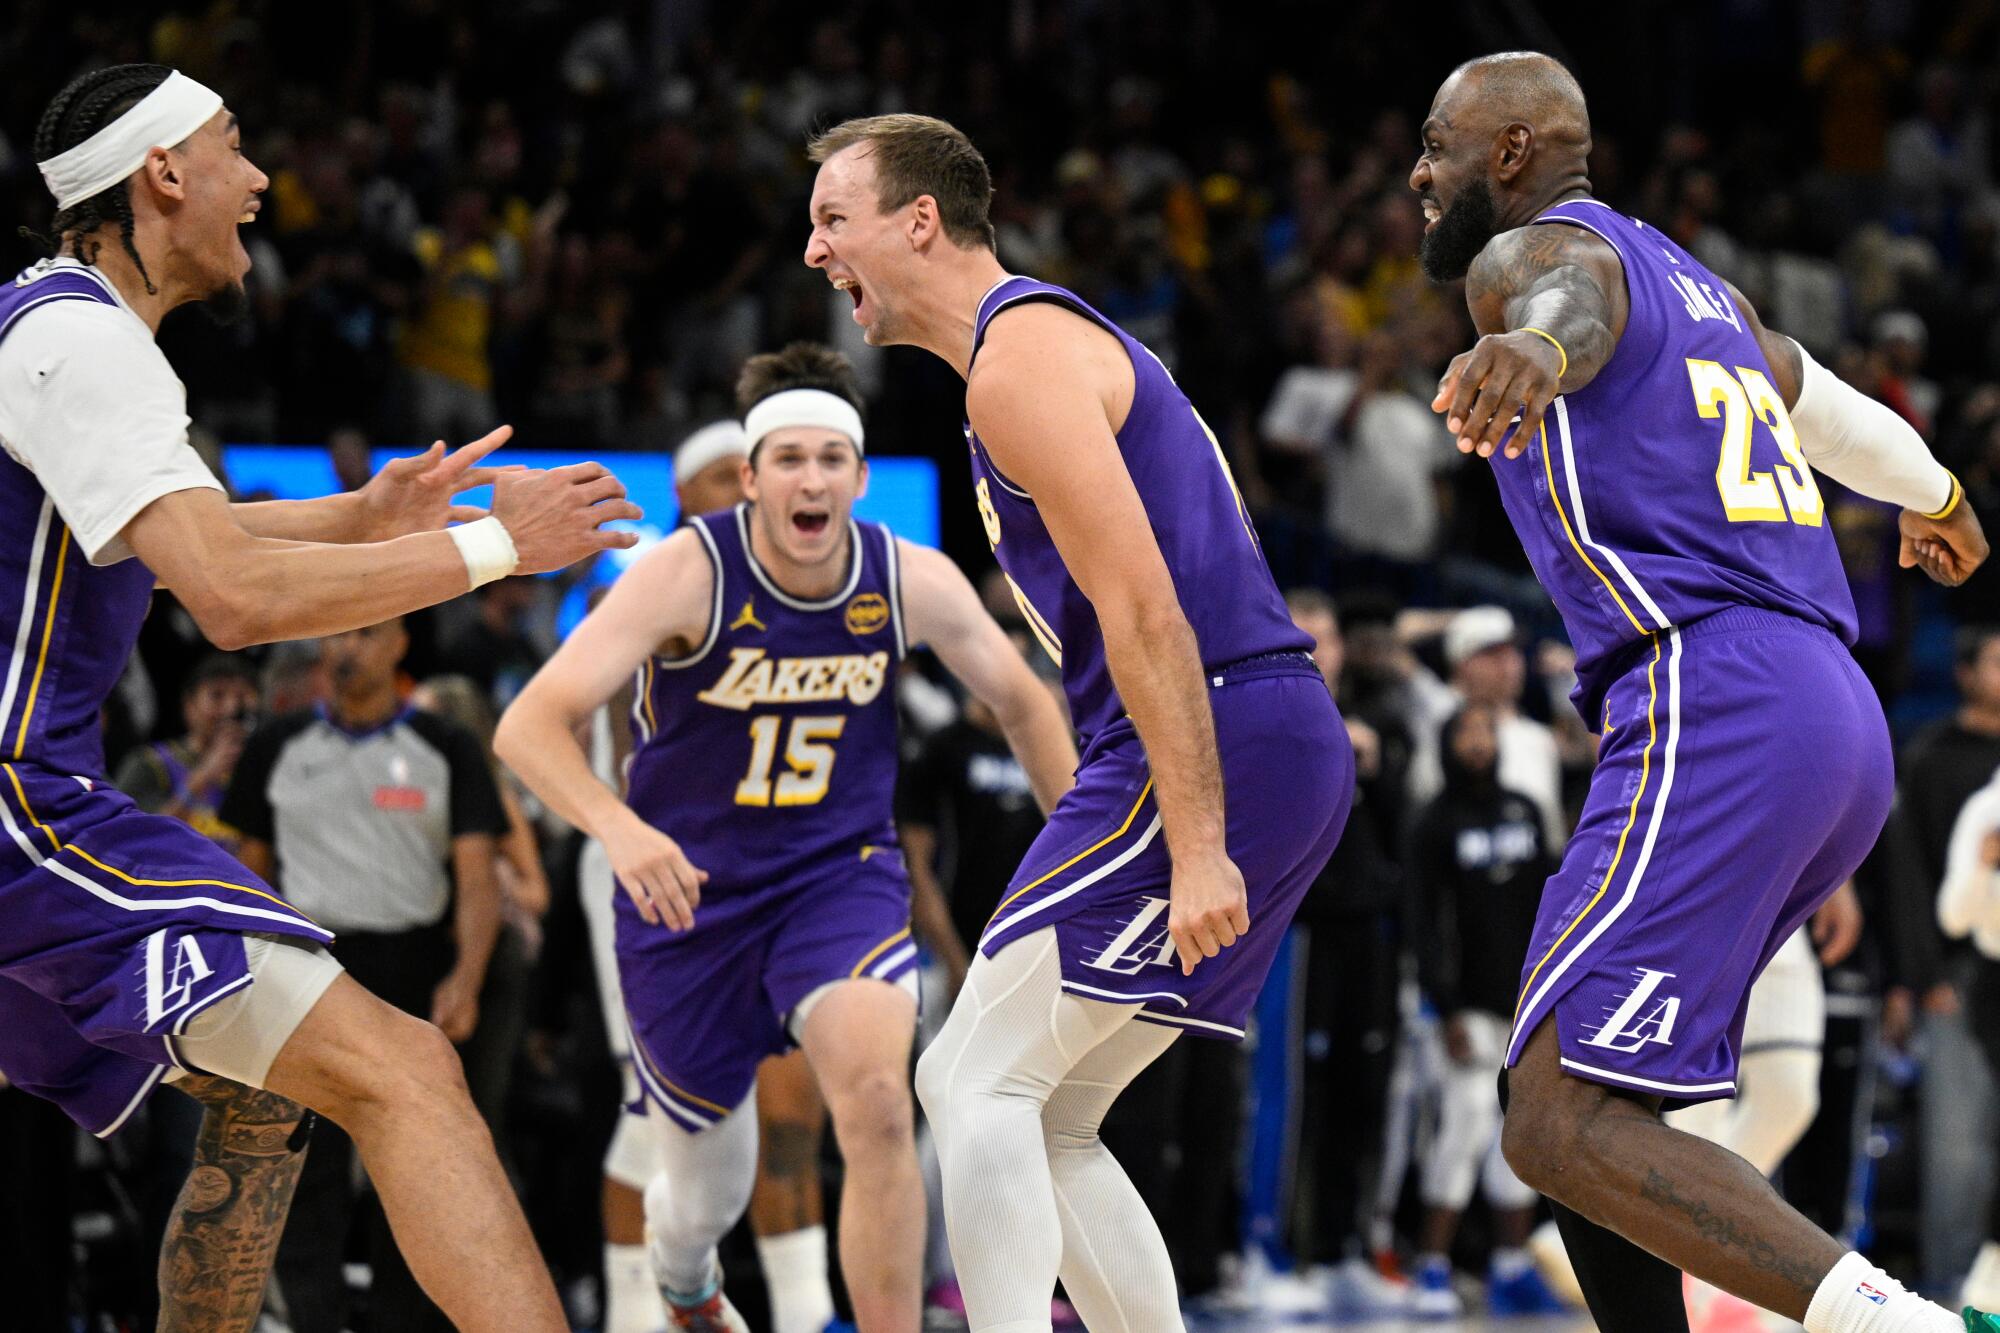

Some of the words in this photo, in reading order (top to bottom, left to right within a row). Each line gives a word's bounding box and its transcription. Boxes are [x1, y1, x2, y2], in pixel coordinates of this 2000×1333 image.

[1685, 358, 1825, 528] 23
[734, 715, 847, 807] 15
[133, 928, 215, 1034] LA
[1079, 896, 1174, 975] LA
[1578, 966, 1681, 1053] LA
